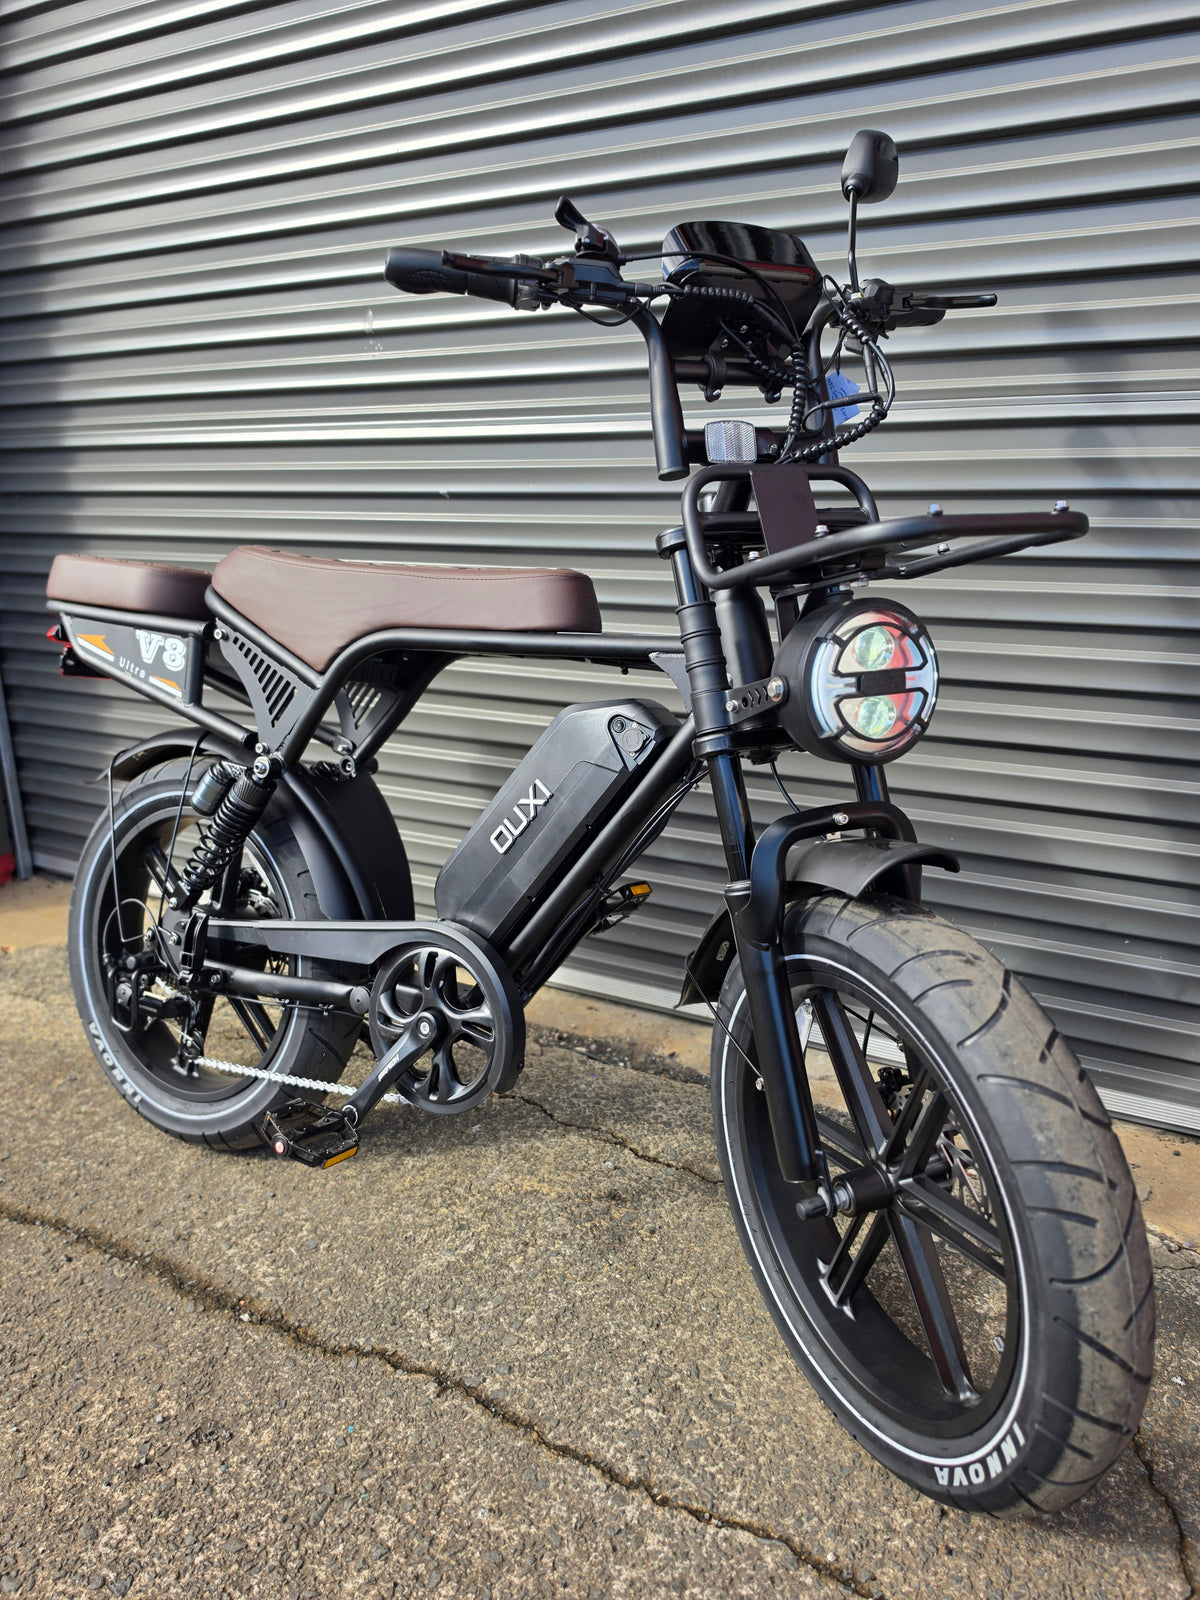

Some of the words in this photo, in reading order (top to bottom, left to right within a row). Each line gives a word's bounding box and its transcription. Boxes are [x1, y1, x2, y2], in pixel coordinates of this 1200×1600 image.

[119, 656, 146, 678] Ultra
[135, 629, 187, 672] V8
[489, 778, 553, 855] OUXI
[88, 1021, 143, 1103] INNOVA
[933, 1420, 1026, 1487] INNOVA
